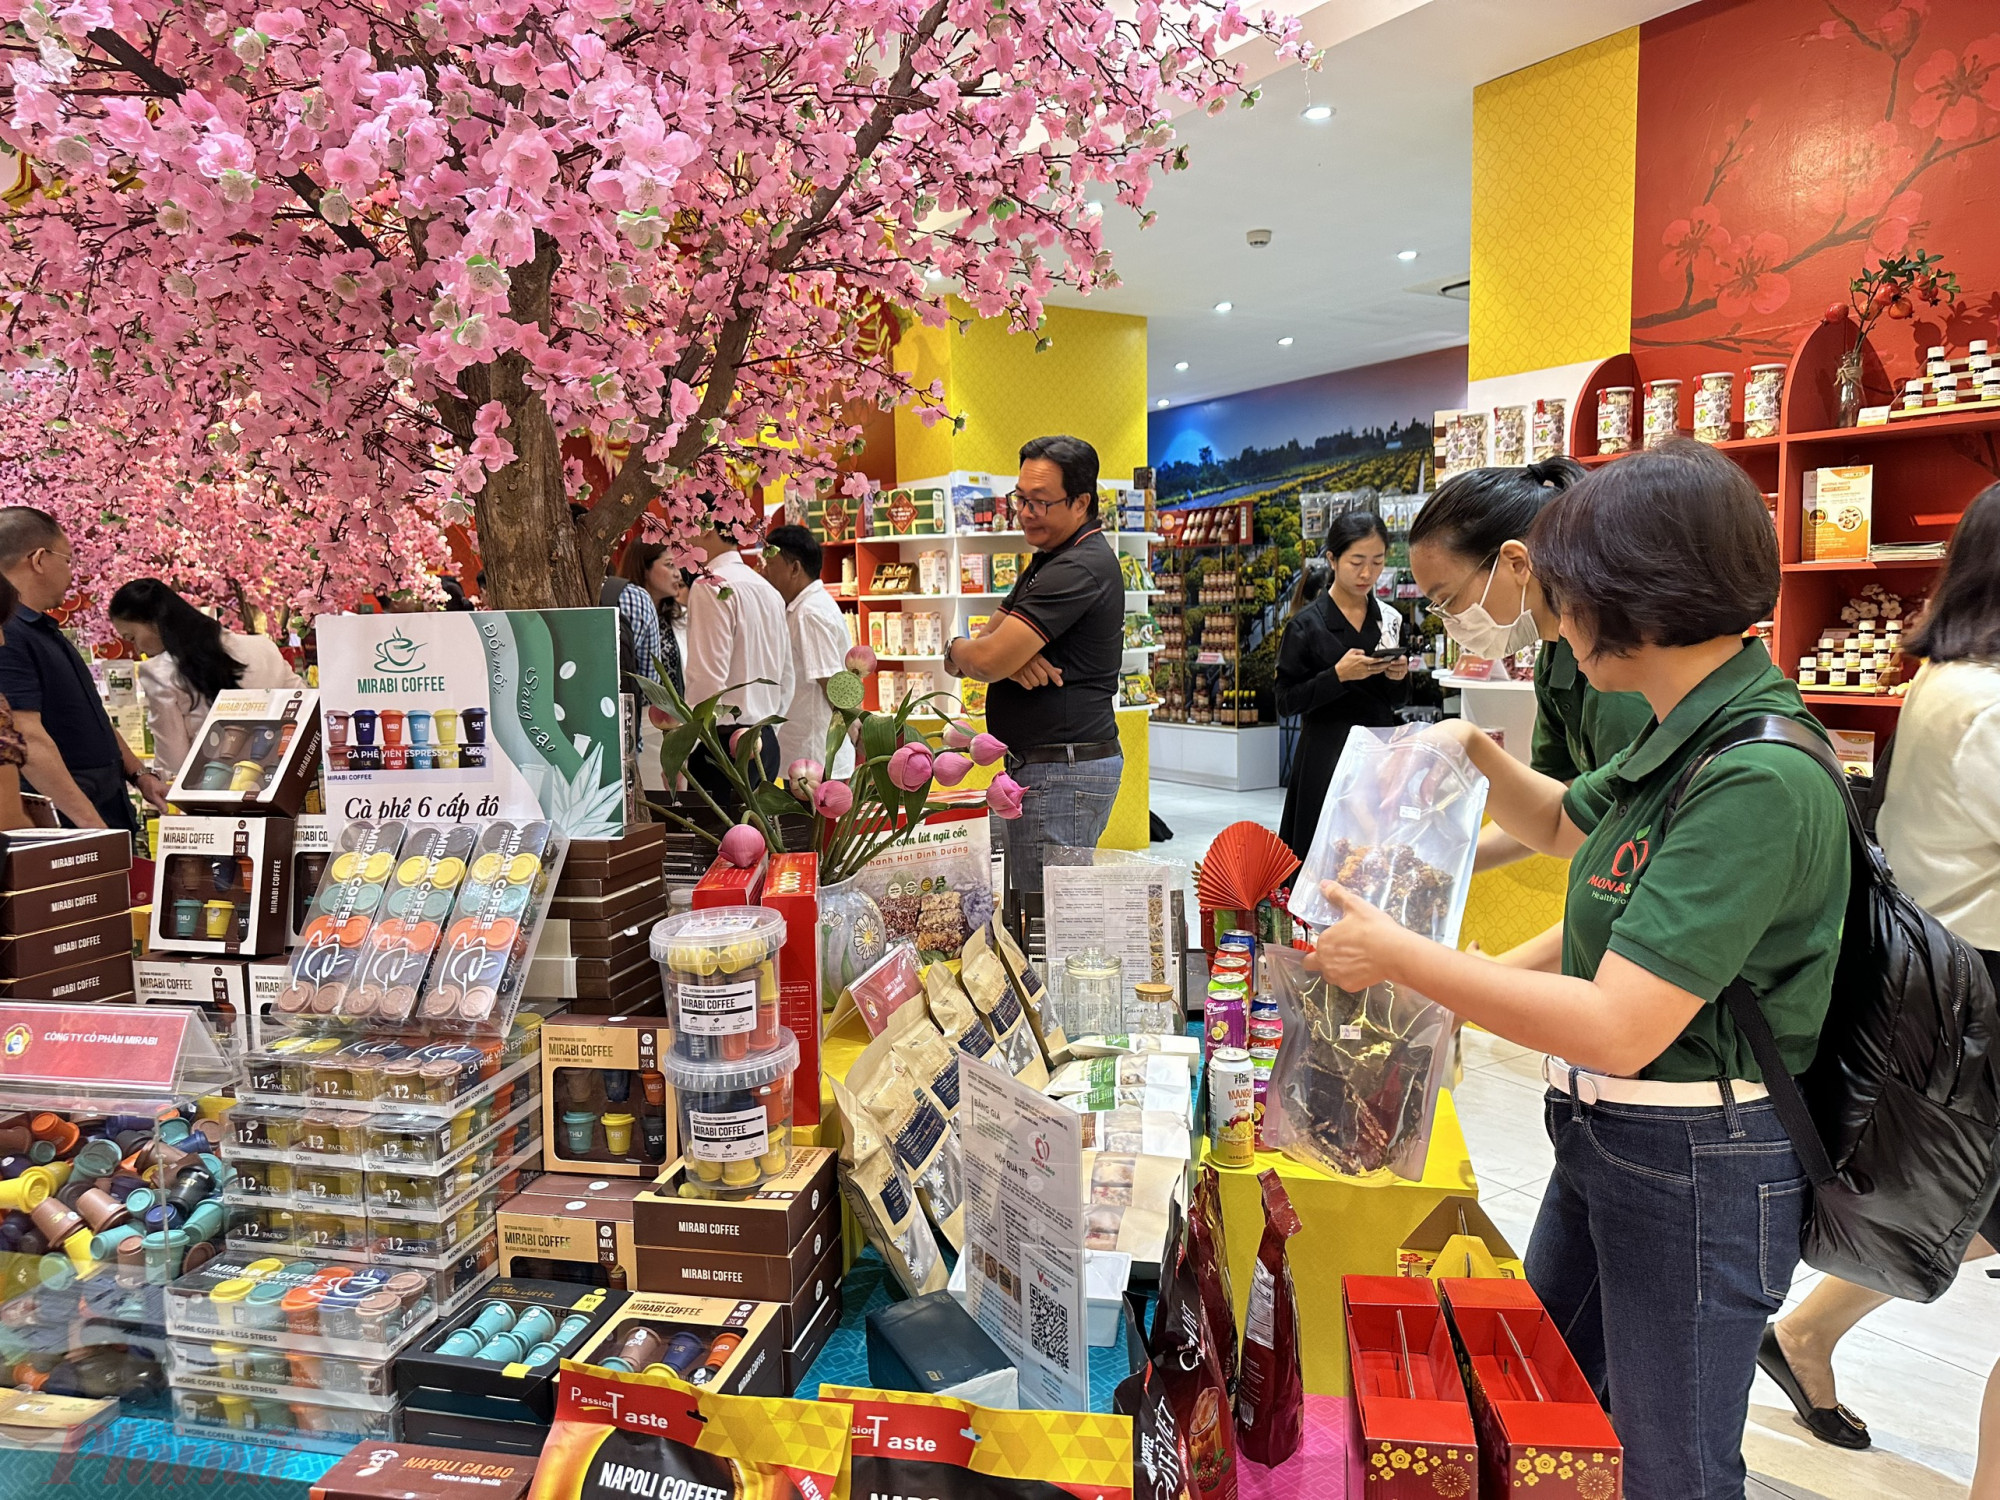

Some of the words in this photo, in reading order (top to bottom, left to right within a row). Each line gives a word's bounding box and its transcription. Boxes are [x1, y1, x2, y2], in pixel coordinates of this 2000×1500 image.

[357, 677, 399, 695] MIRABI
[401, 675, 446, 693] COFFEE
[359, 721, 371, 730] TUE
[386, 723, 400, 731] WED
[413, 722, 427, 731] THU
[471, 720, 484, 729] SAT
[297, 753, 312, 778] MIRABI
[308, 731, 323, 755] COFFEE
[346, 748, 364, 759] CÀ
[365, 748, 380, 759] PHÊ
[382, 747, 403, 759] VIÊN
[404, 748, 449, 758] ESPRESSO
[327, 774, 348, 782] MIRABI
[349, 773, 373, 781] COFFEE
[344, 797, 372, 820] Cà
[378, 797, 411, 823] phê
[417, 797, 431, 818] 6
[437, 792, 470, 824] cấp
[163, 832, 189, 844] MIRABI
[189, 833, 215, 845] COFFEE
[235, 833, 247, 843] MIX
[51, 857, 75, 870] MIRABI
[75, 851, 99, 866] COFFEE
[355, 829, 382, 876] MIRABI
[426, 833, 451, 879] MIRABI
[499, 829, 524, 876] MIRABI
[917, 850, 937, 860] Dinh
[272, 859, 282, 886] COFFEE
[51, 899, 75, 912] MIRABI
[75, 893, 98, 907] COFFEE
[271, 886, 280, 914] MIRABI
[336, 877, 362, 928] COFFEE
[405, 881, 431, 932] COFFEE
[481, 879, 507, 931] COFFEE
[54, 941, 78, 955] MIRABI
[78, 934, 101, 949] COFFEE
[52, 983, 76, 998] MIRABI
[77, 976, 101, 991] COFFEE
[139, 977, 166, 990] MIRABI
[166, 978, 194, 990] COFFEE
[681, 998, 706, 1010] MIRABI
[707, 998, 736, 1010] COFFEE
[70, 1032, 83, 1043] TY
[124, 1036, 159, 1046] MIRABI
[548, 1043, 579, 1057] MIRABI
[581, 1045, 614, 1058] COFFEE
[640, 1046, 655, 1056] MIX
[468, 1062, 479, 1075] CÀ
[454, 1093, 472, 1110] MIRABI
[471, 1083, 490, 1100] COFFEE
[1228, 1088, 1252, 1101] MANGO
[1234, 1099, 1249, 1108] JUICE
[648, 1134, 664, 1142] SAT
[693, 1125, 717, 1137] MIRABI
[718, 1125, 747, 1137] COFFEE
[441, 1154, 457, 1168] MORE
[457, 1139, 476, 1158] COFFEE
[490, 1120, 507, 1136] STRESS
[1006, 1160, 1018, 1176] QUÀ
[1018, 1167, 1028, 1180] TẾT
[460, 1186, 480, 1204] COFFEE
[482, 1174, 494, 1188] LESS
[494, 1164, 511, 1181] STRESS
[678, 1221, 708, 1234] MIRABI
[710, 1223, 740, 1236] COFFEE
[447, 1246, 463, 1261] MORE
[462, 1232, 481, 1251] COFFEE
[504, 1231, 536, 1246] MIRABI
[538, 1234, 571, 1248] COFFEE
[600, 1239, 614, 1248] MIX
[465, 1254, 476, 1269] CÀ
[210, 1263, 262, 1278] MIRABI
[265, 1271, 325, 1284] COFFEE
[681, 1267, 711, 1281] MIRABI
[712, 1270, 743, 1283] COFFEE
[468, 1274, 486, 1292] COFFEE
[628, 1302, 665, 1313] MIRABI
[665, 1306, 703, 1317] COFFEE
[732, 1310, 748, 1318] MIX
[174, 1323, 196, 1333] MORE
[197, 1327, 225, 1336] COFFEE
[231, 1331, 249, 1339] LESS
[250, 1333, 278, 1342] STRESS
[751, 1348, 766, 1377] COFFEE
[175, 1376, 197, 1385] MORE
[198, 1379, 226, 1388] COFFEE
[231, 1383, 249, 1391] LESS
[250, 1386, 278, 1395] STRESS
[571, 1386, 614, 1409] Passion
[605, 1391, 669, 1429] Taste
[207, 1431, 235, 1440] COFFEE
[866, 1415, 937, 1452] Taste
[403, 1456, 461, 1472] NAPOLI
[432, 1472, 460, 1482] Cocoa
[460, 1476, 481, 1484] with
[481, 1478, 502, 1487] milk
[598, 1462, 660, 1500] NAPOLI
